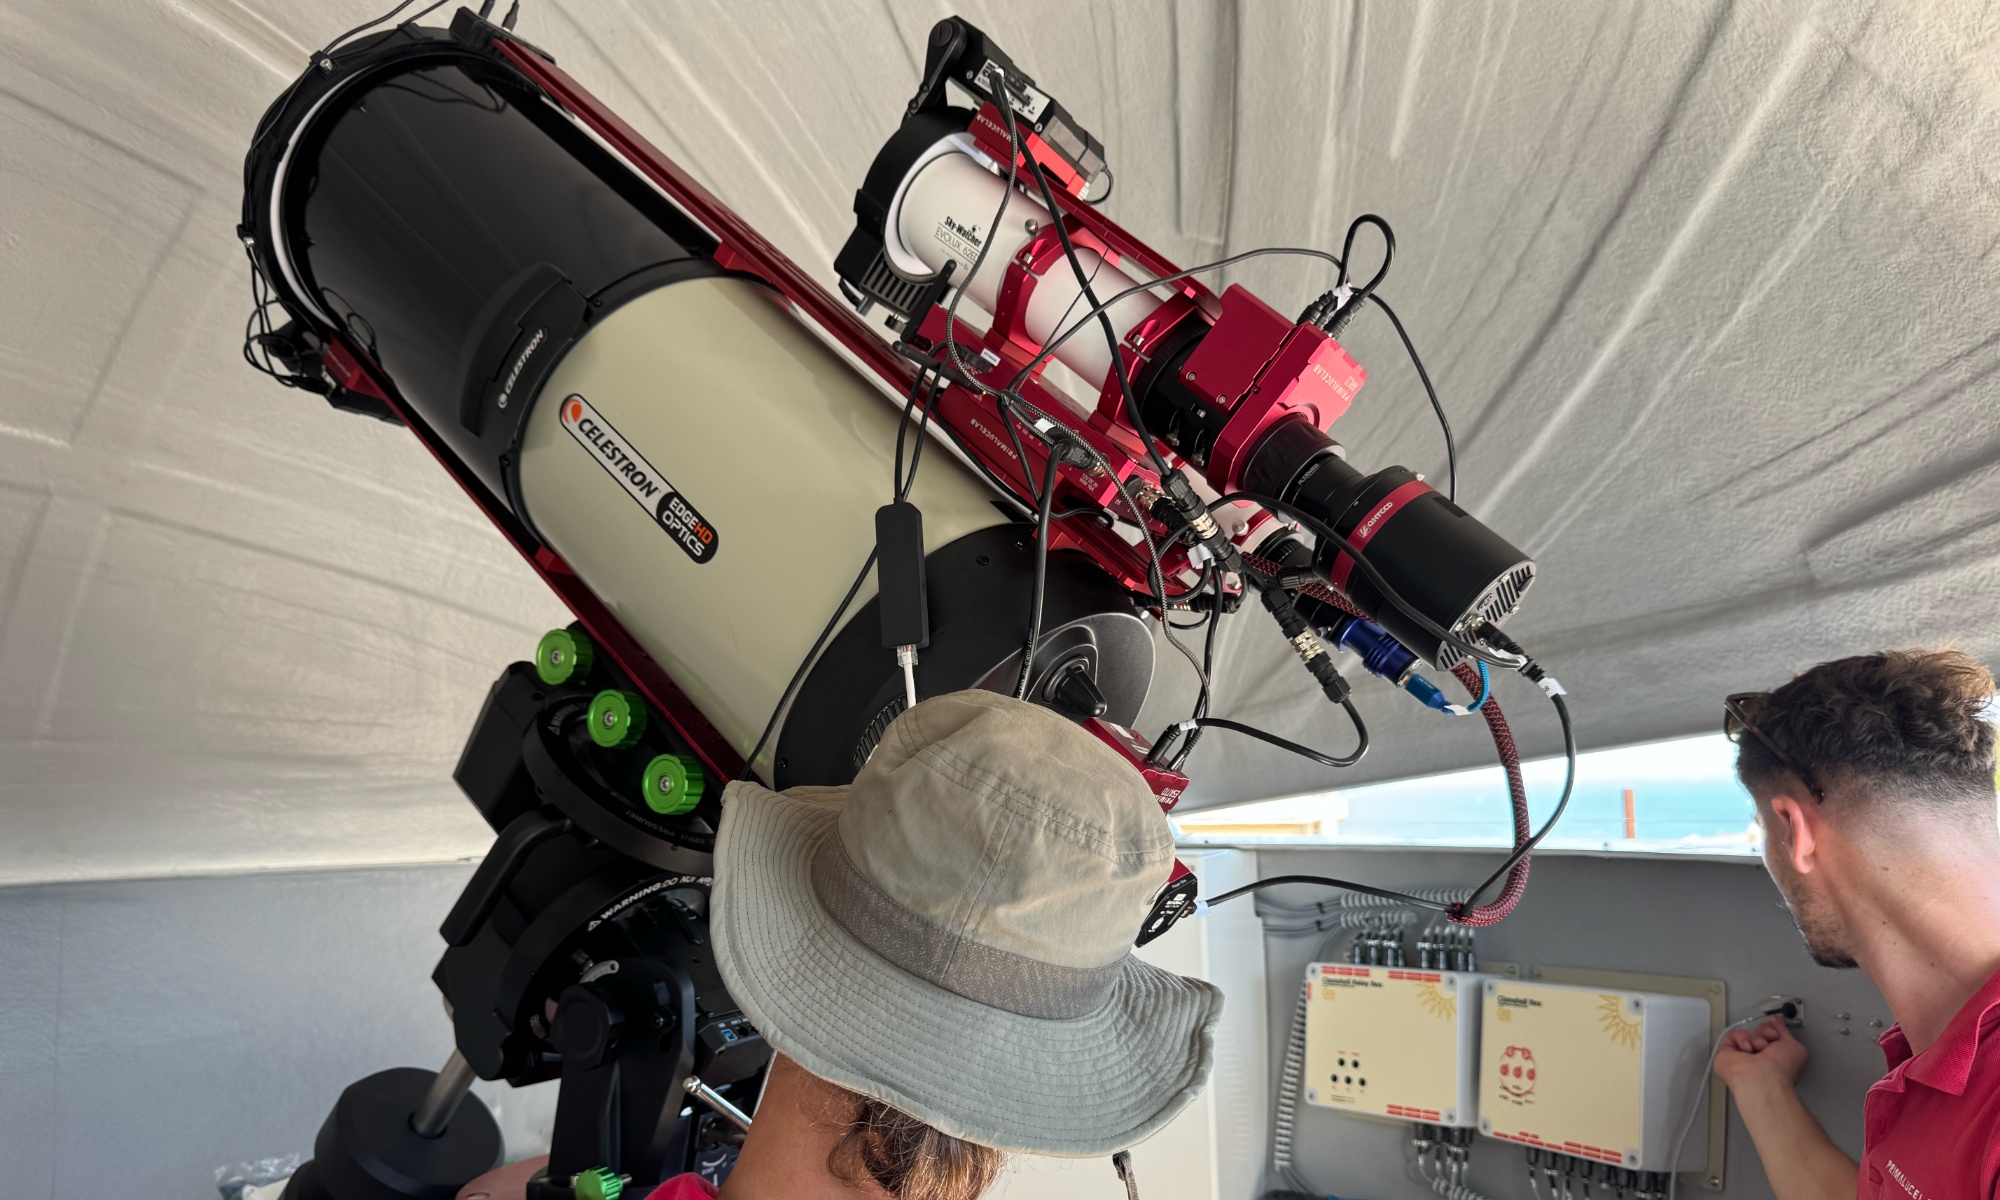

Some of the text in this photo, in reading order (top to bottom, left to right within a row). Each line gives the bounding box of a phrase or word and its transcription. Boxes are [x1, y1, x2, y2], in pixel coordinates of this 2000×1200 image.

[976, 113, 1012, 142] MALUCELAB
[935, 226, 962, 251] EVOLUX
[944, 215, 982, 248] Sky-Watcher
[504, 328, 544, 395] CELESTRON
[1313, 363, 1351, 402] PRIMALUCELAB
[577, 418, 659, 498] CELESTRON
[970, 418, 1018, 460] PRIMALUCELAB
[661, 509, 706, 557] OPTICS
[668, 496, 714, 545] EDGEHD
[1367, 501, 1393, 527] QHYCCD
[1885, 1159, 1932, 1200] PRIMALUCE
